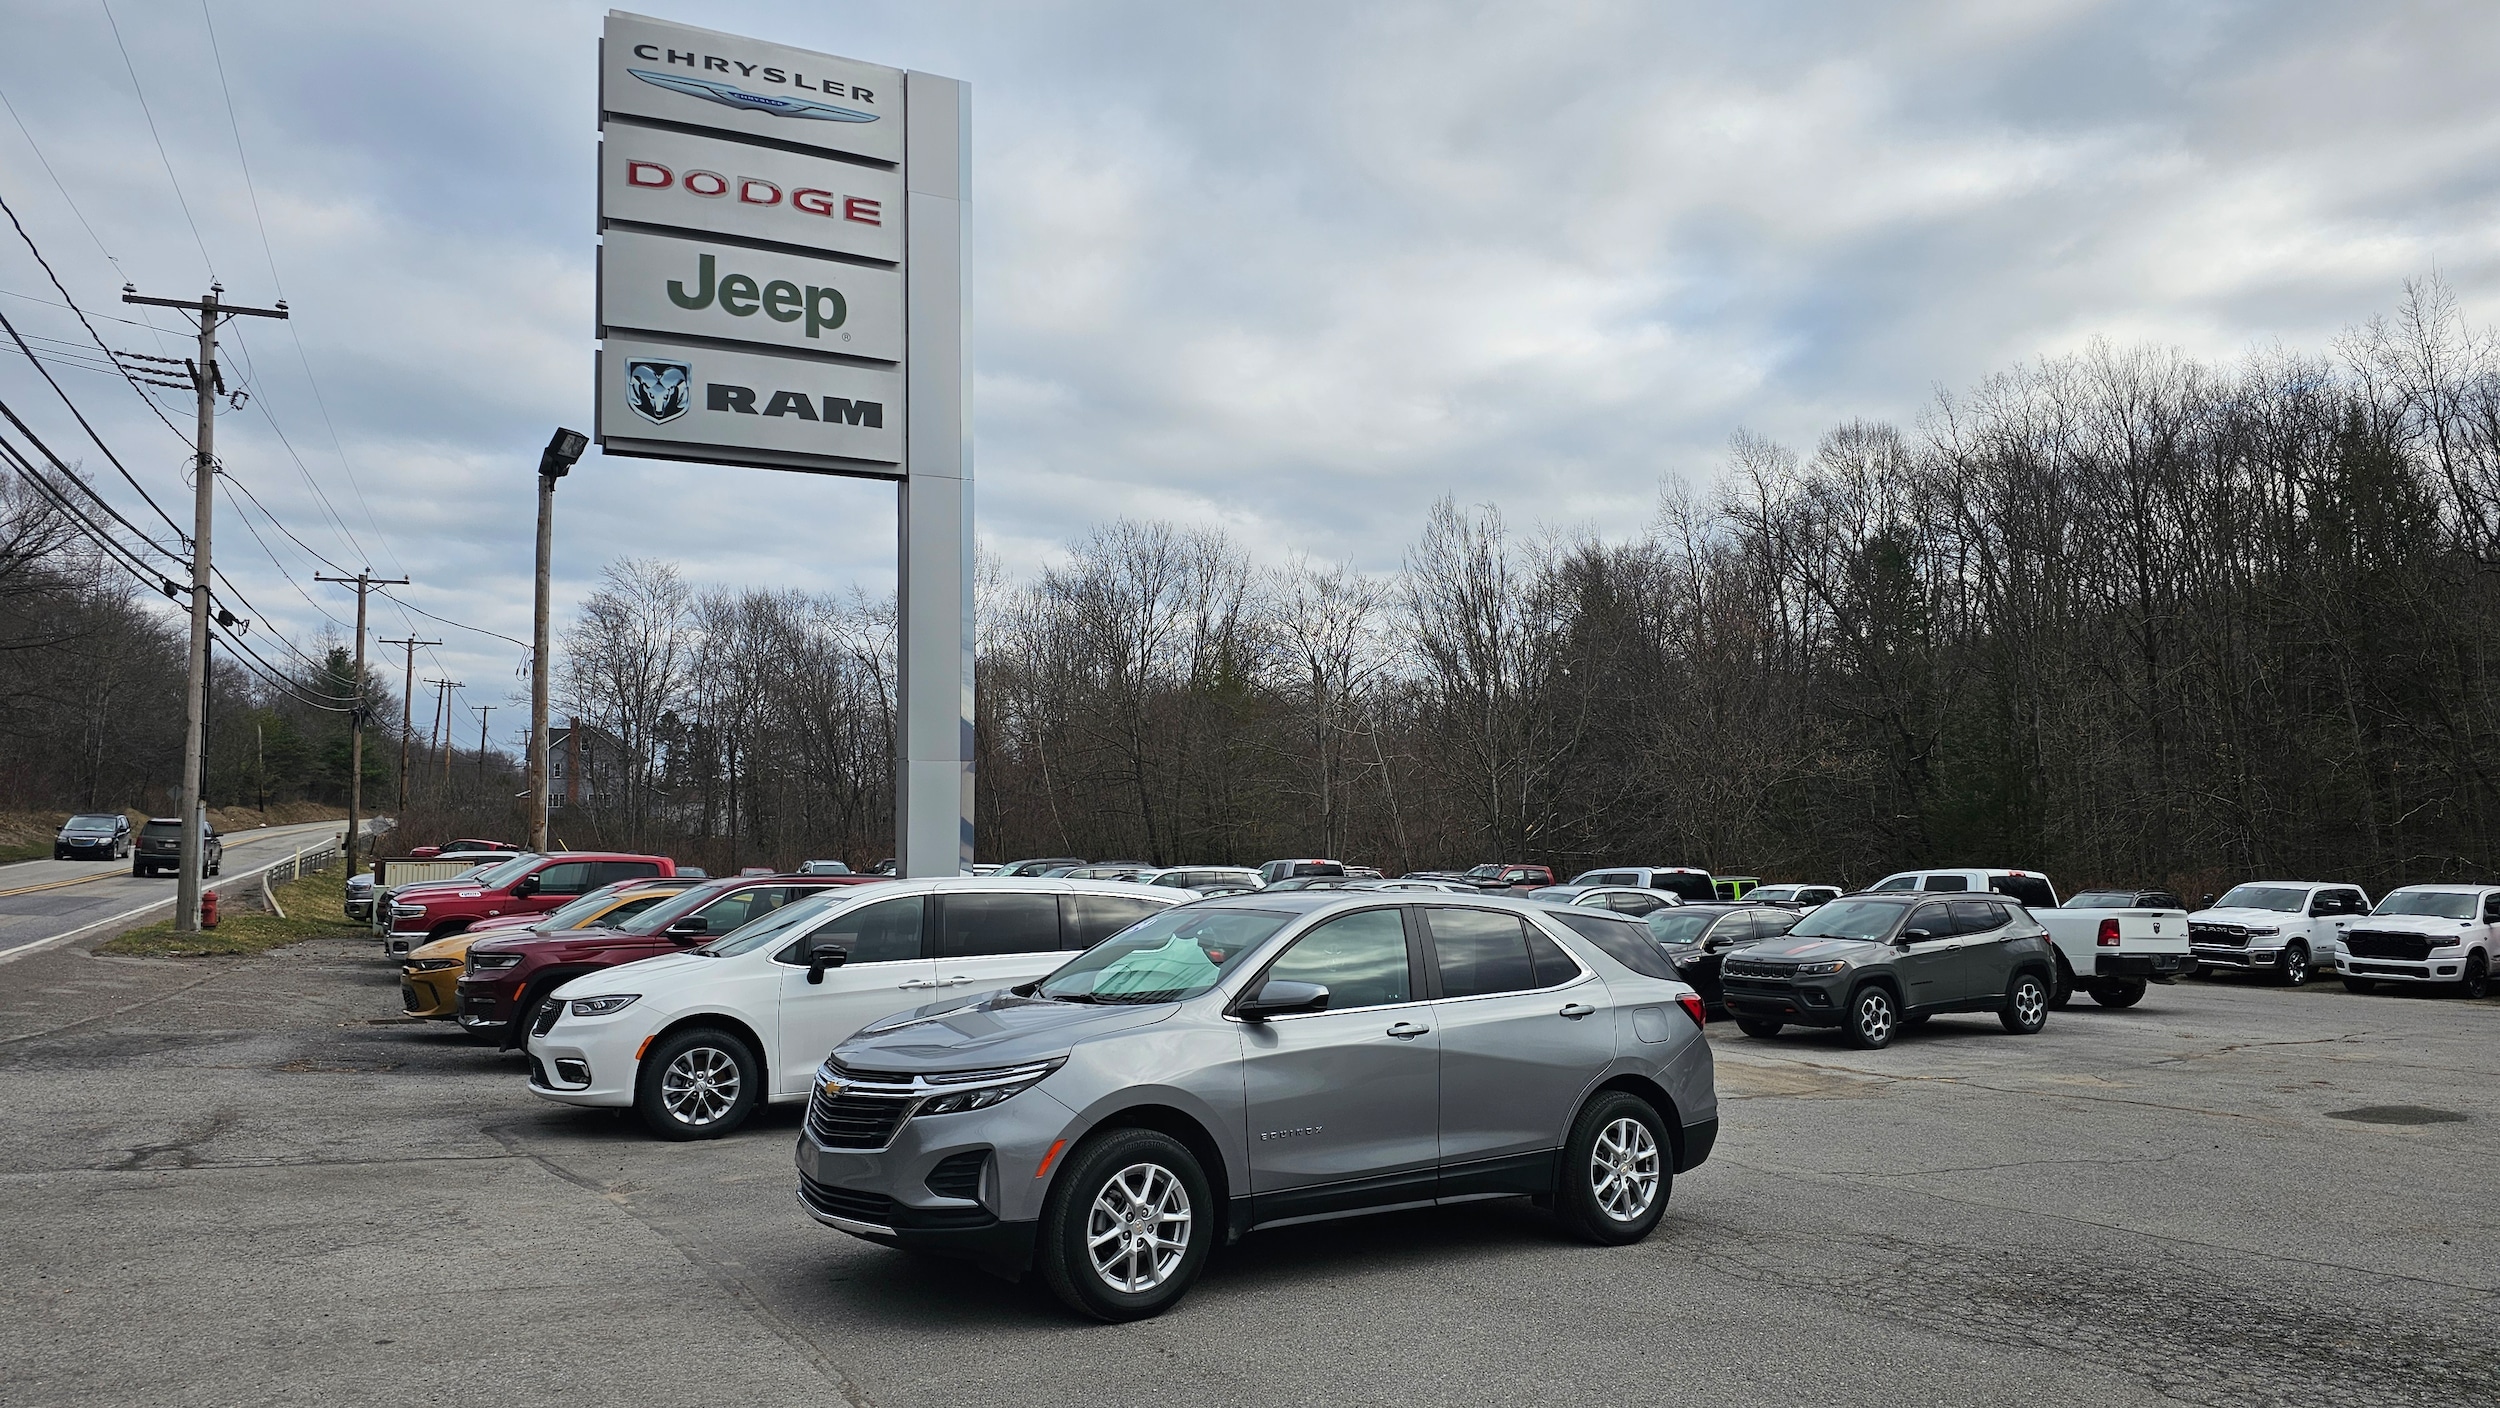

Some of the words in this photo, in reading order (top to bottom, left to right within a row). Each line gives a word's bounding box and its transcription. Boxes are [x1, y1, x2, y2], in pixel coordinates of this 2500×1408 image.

[633, 44, 875, 104] CHRYSLER
[626, 159, 882, 228] DODGE
[666, 253, 847, 339] Jeep
[707, 383, 883, 429] RAM
[1260, 1125, 1324, 1141] EQUINOX
